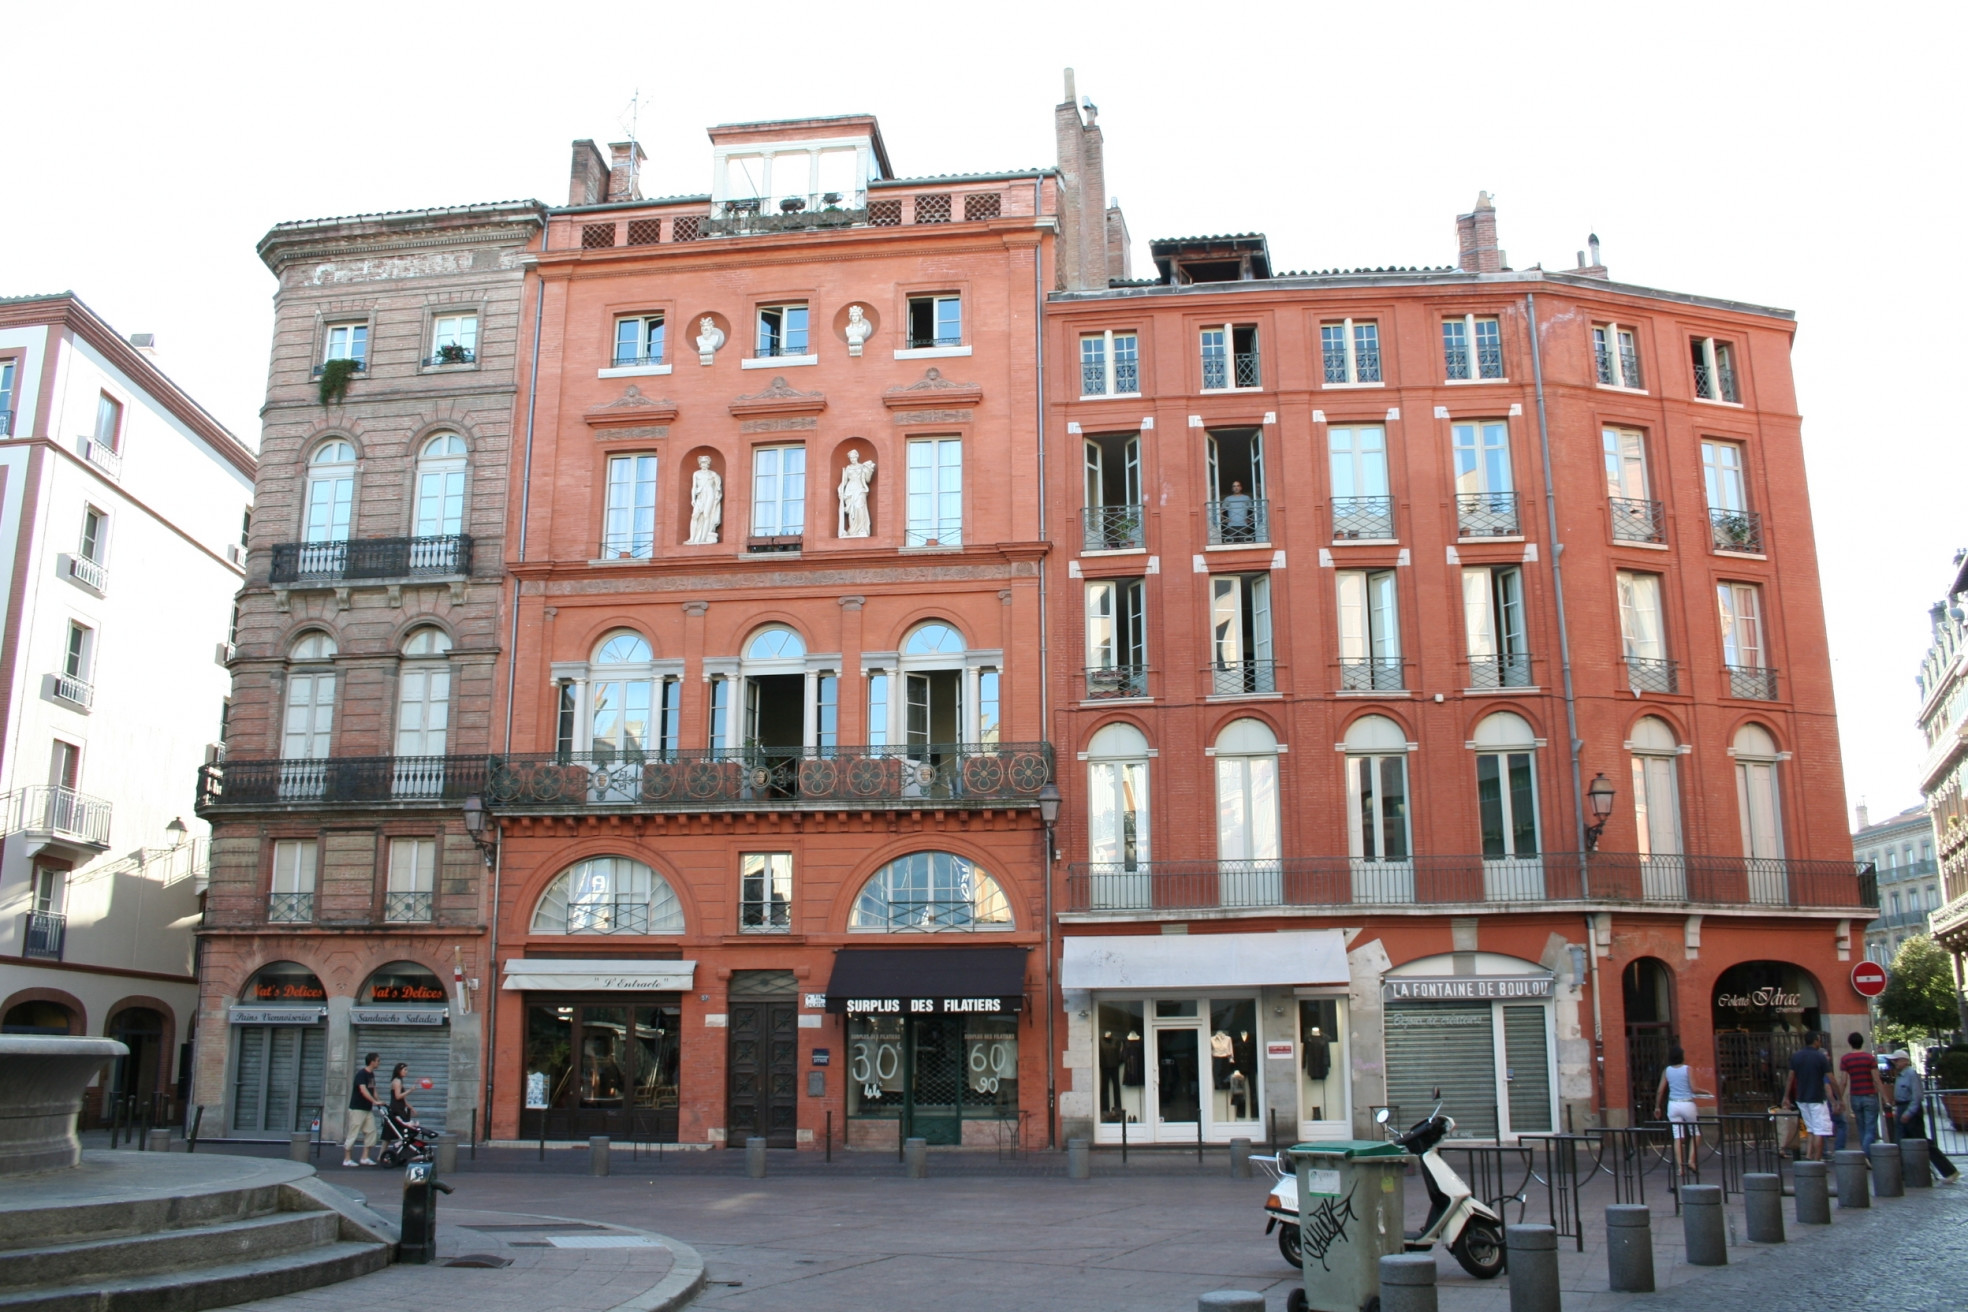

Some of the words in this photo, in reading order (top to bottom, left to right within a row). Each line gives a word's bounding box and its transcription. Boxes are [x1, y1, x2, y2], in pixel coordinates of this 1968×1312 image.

[250, 984, 280, 998] Nat's
[367, 985, 398, 998] Nat's
[1393, 983, 1409, 998] LA
[1413, 982, 1474, 997] FONTAINE
[1479, 982, 1495, 996] DE
[1499, 981, 1549, 996] BOULOU
[1752, 986, 1801, 1006] Idrac
[847, 999, 900, 1013] SURPLUS
[911, 999, 934, 1013] DES
[944, 998, 1001, 1012] FILATIERS
[404, 1013, 437, 1023] Salades
